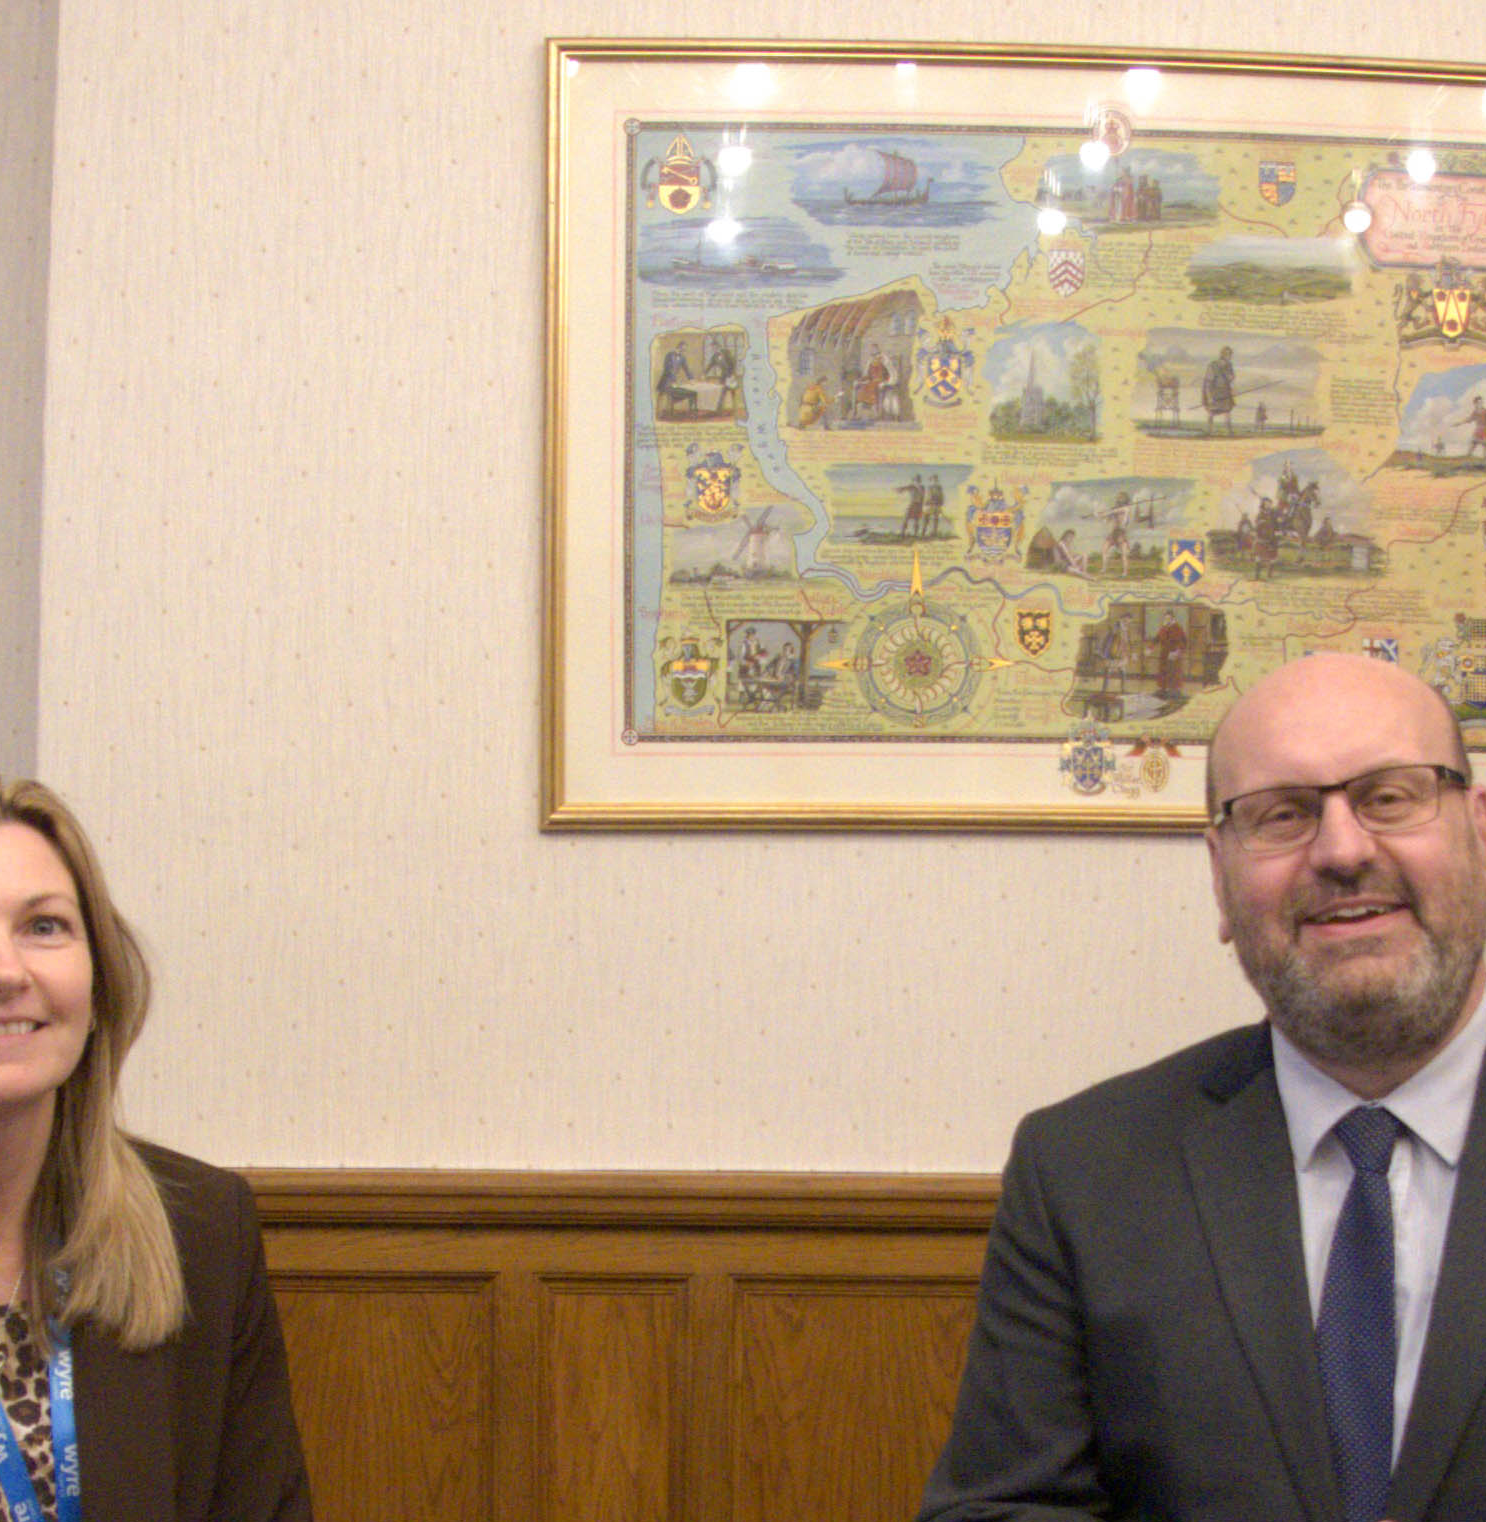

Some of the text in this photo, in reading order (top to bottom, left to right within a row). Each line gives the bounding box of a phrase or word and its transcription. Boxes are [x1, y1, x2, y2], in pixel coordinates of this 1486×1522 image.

[1380, 194, 1455, 229] North
[54, 1349, 74, 1401] wyre
[60, 1443, 80, 1498] wyre
